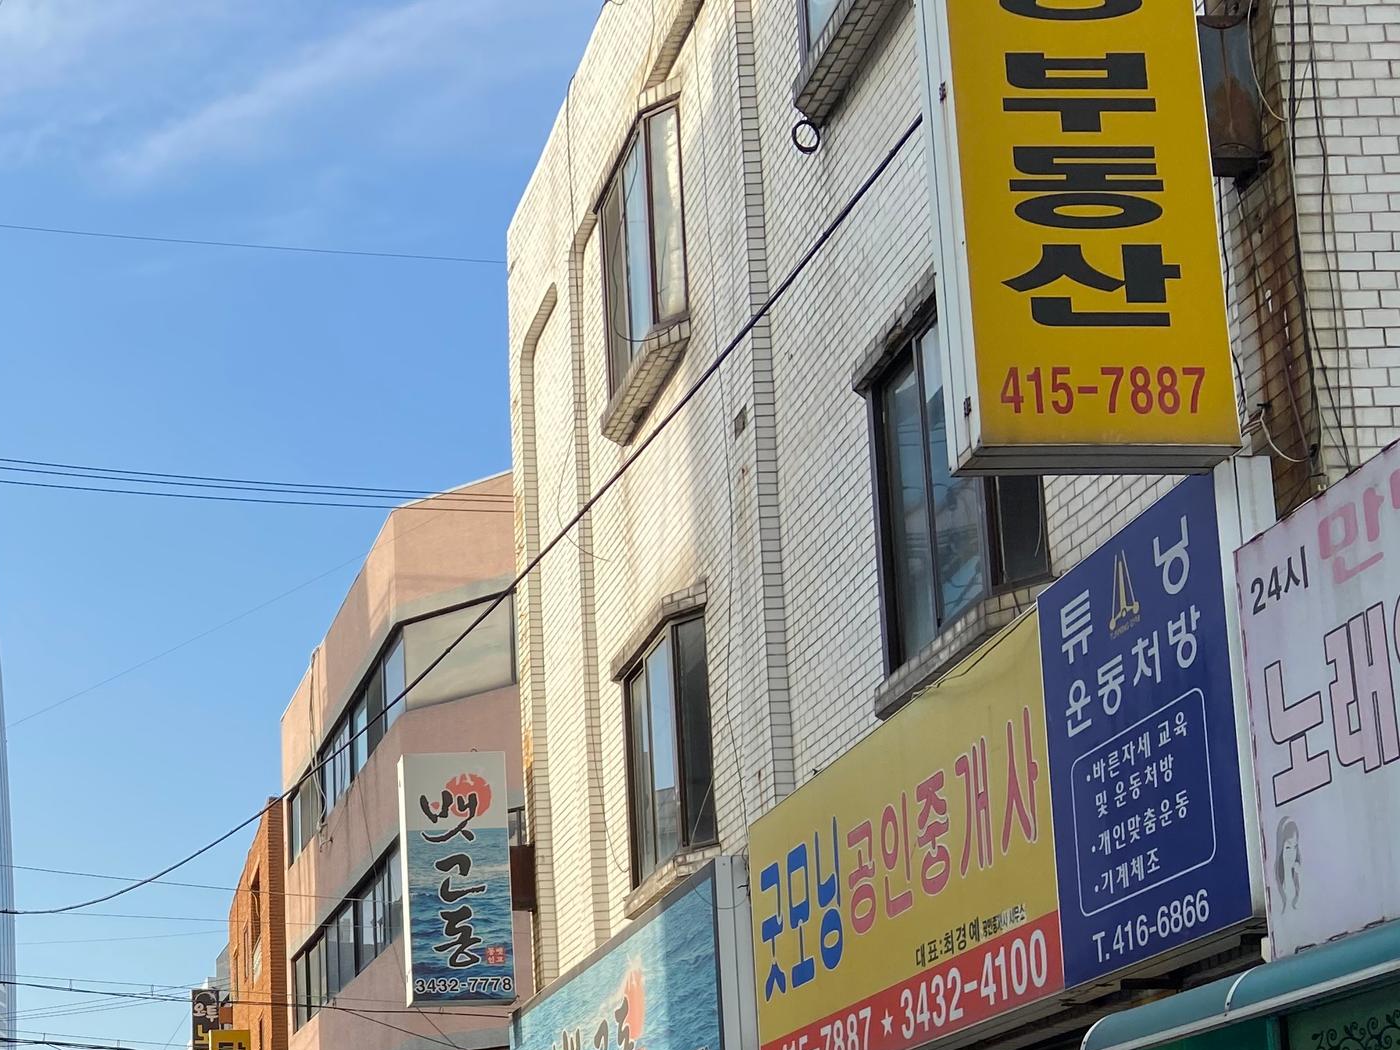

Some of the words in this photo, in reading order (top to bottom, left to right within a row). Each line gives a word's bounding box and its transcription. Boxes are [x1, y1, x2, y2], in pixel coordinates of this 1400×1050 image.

[1000, 366, 1206, 416] 415-7887
[1318, 468, 1400, 585] 만
[1250, 545, 1310, 616] 24시
[1065, 604, 1201, 738] 운동처방
[1264, 594, 1400, 807] 노래
[1093, 731, 1151, 783] 바른자세
[1158, 711, 1188, 748] 교육
[1095, 791, 1108, 818] 및
[1114, 754, 1174, 808] 운동처방
[1098, 790, 1190, 856] 개인맞춤운동
[1101, 848, 1161, 894] 기계체조
[414, 976, 514, 996] 3432-7778
[900, 928, 1049, 1042] 3432-4100
